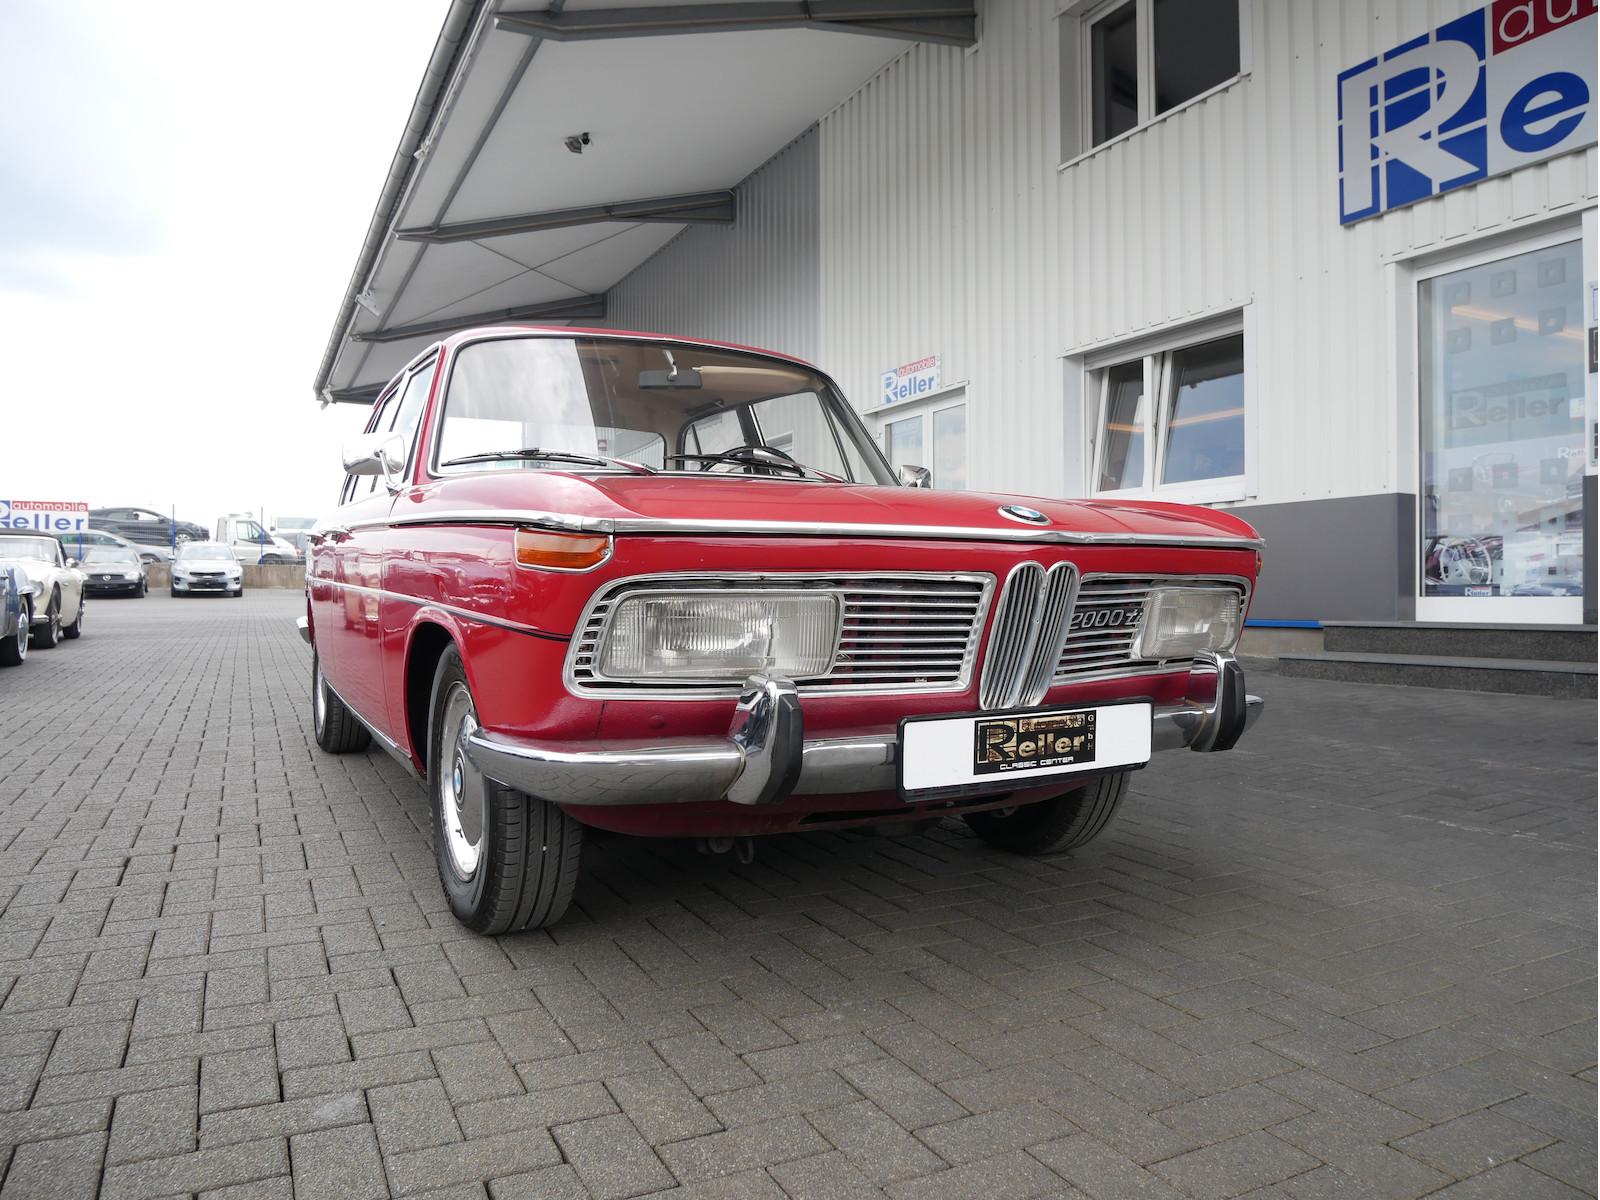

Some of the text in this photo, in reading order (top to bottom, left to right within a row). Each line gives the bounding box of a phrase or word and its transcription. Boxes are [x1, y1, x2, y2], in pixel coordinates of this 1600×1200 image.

[880, 368, 935, 405] Reller
[13, 501, 87, 512] automobile
[1070, 609, 1124, 629] 2000
[979, 721, 1085, 764] Reller
[1000, 756, 1074, 770] CLASSIC CENTER
